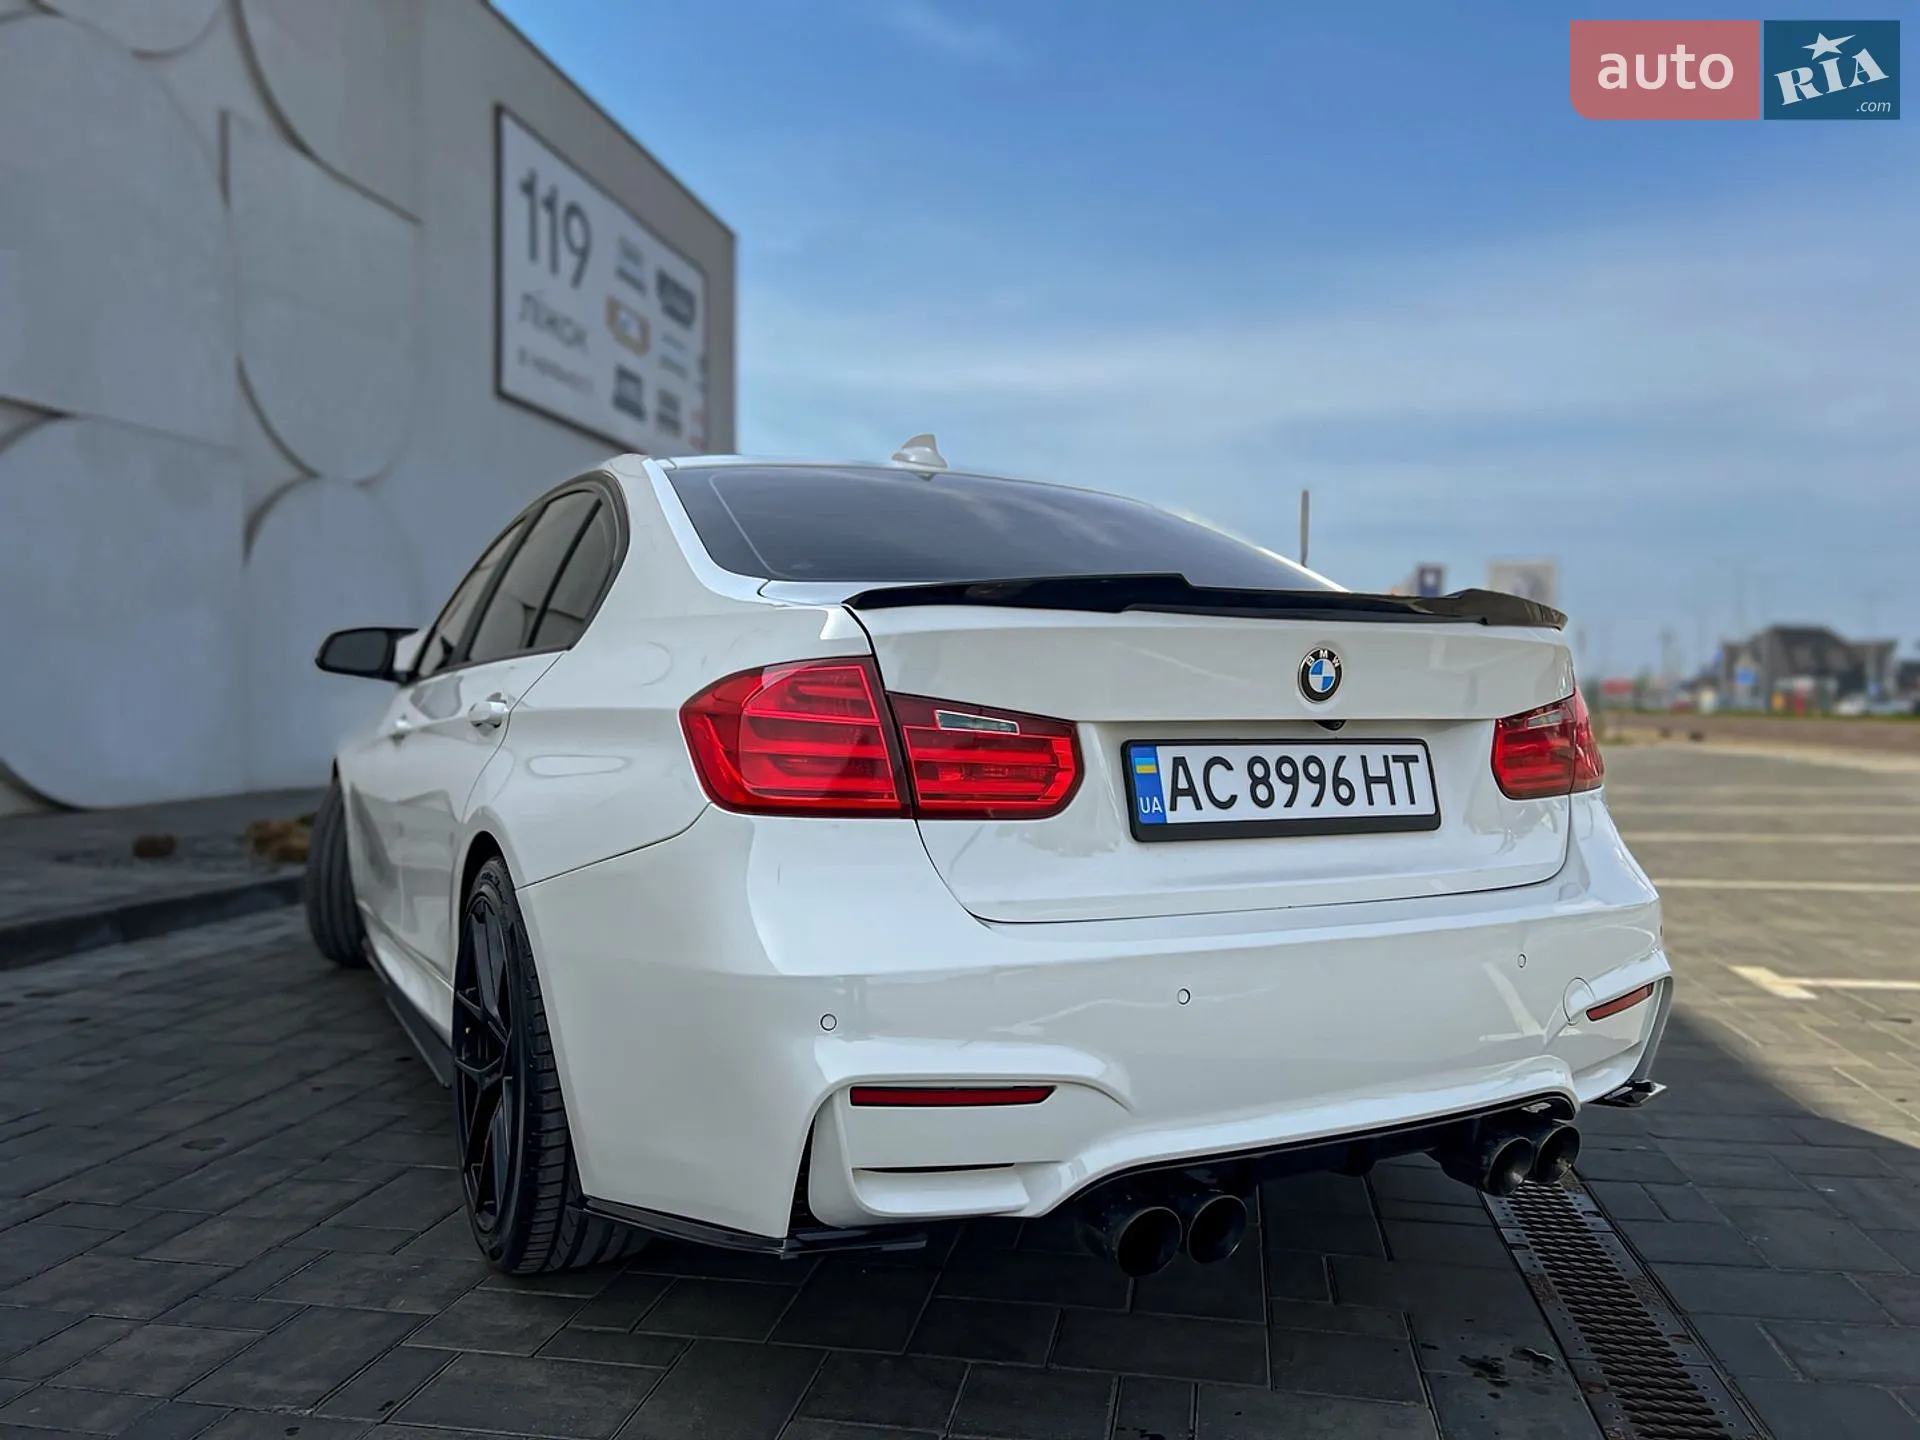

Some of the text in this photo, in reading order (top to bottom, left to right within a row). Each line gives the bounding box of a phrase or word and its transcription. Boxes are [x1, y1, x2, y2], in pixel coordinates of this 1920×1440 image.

[518, 167, 593, 290] 119
[1305, 649, 1341, 667] BMW
[1168, 753, 1421, 812] AC 8996 HT
[1140, 795, 1165, 815] UA
